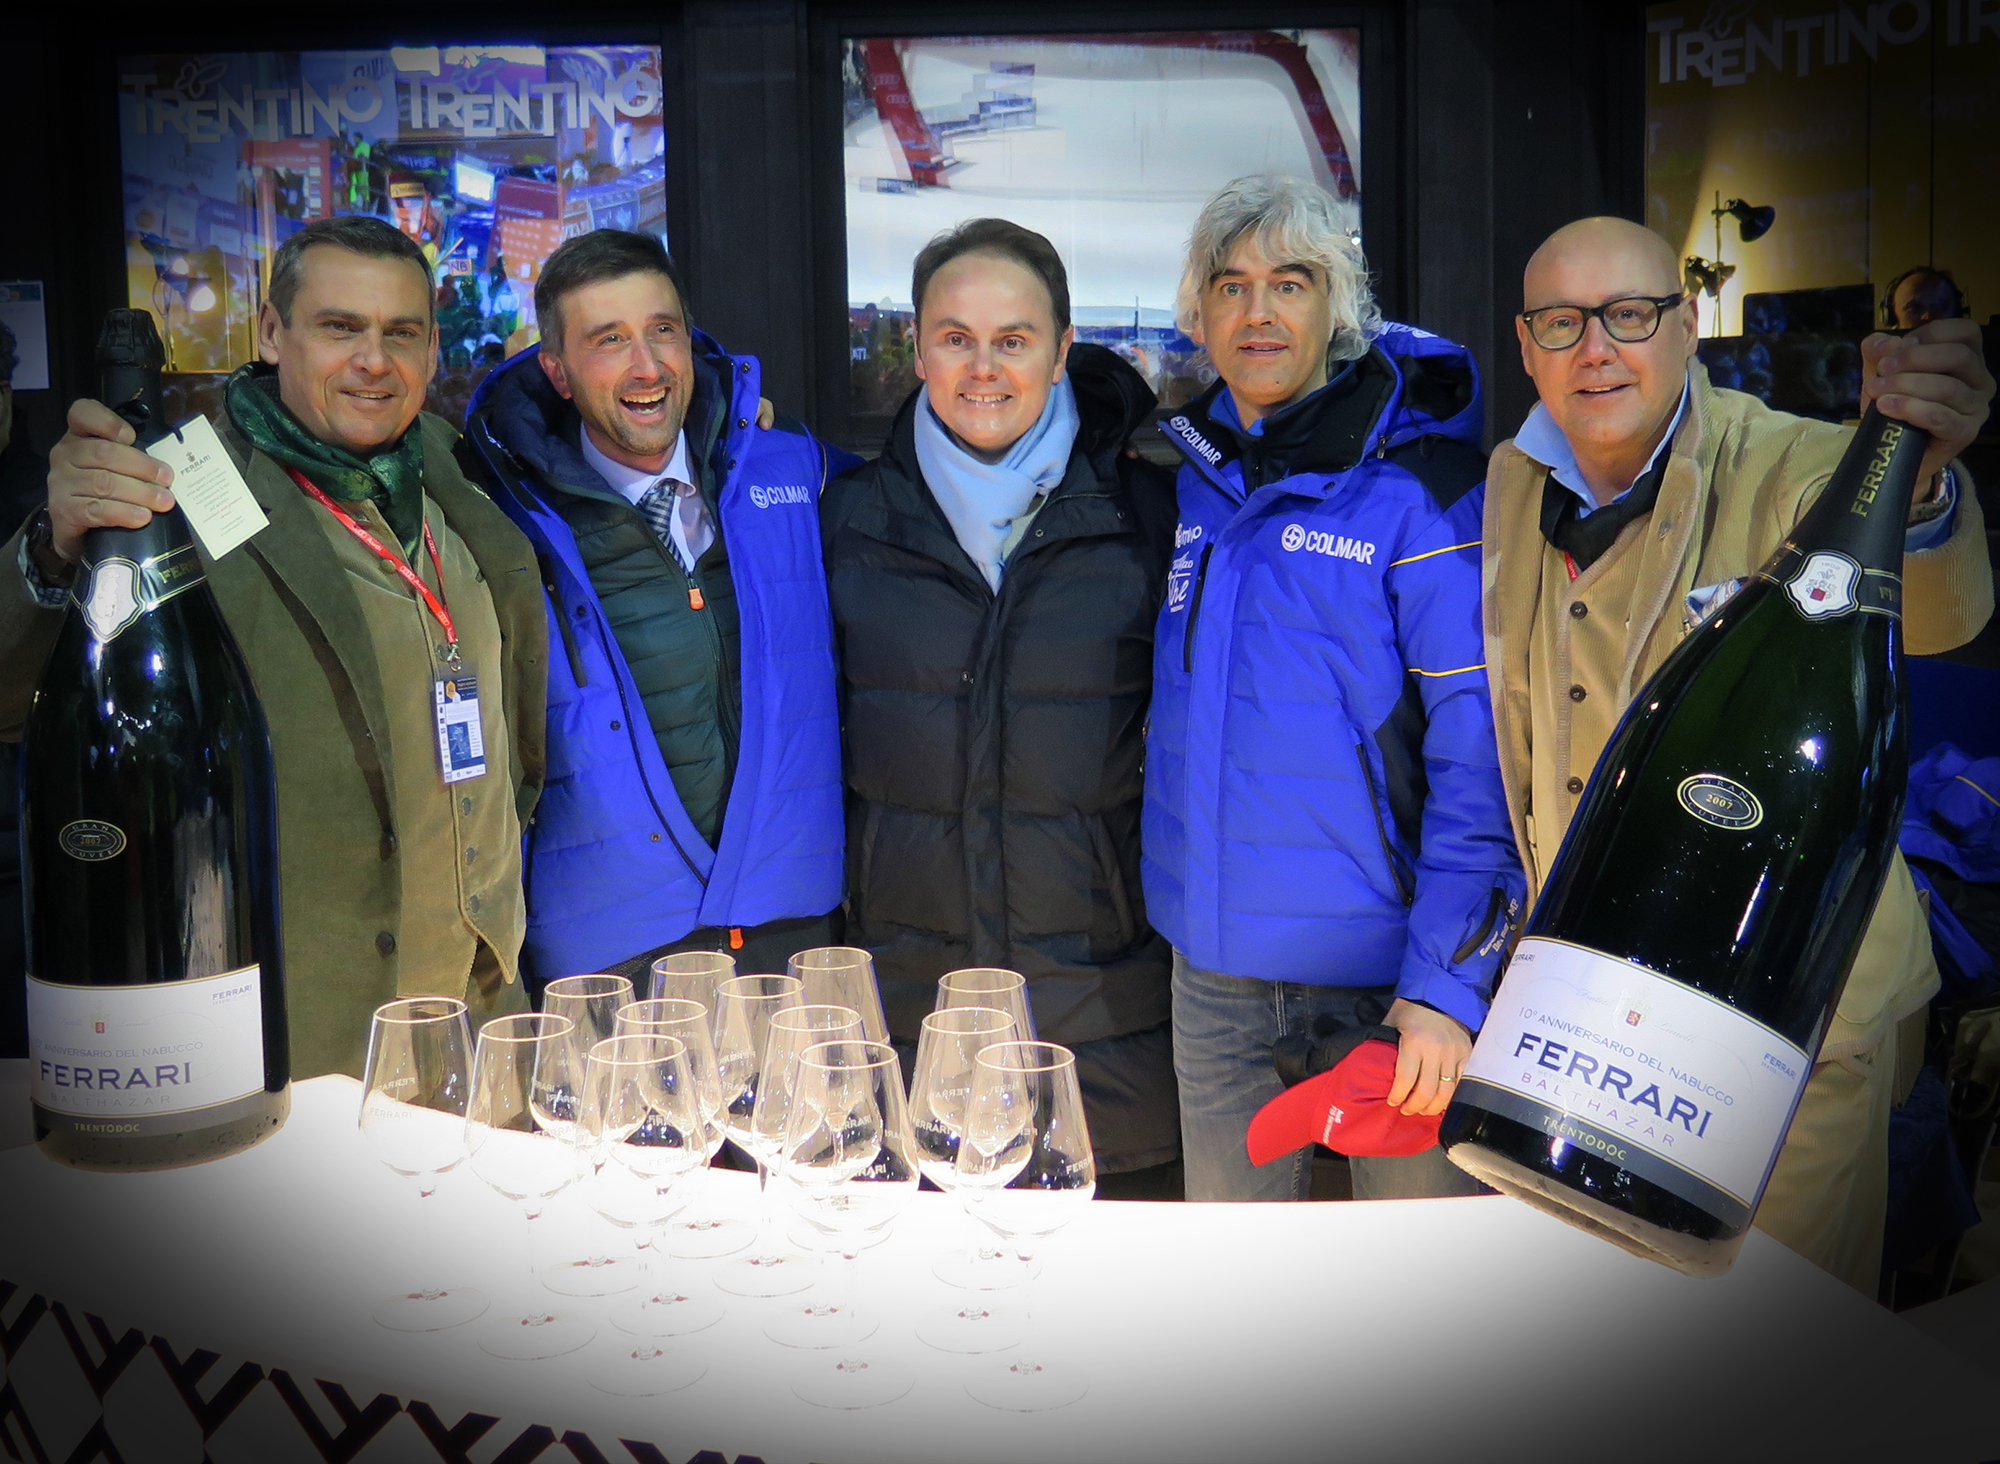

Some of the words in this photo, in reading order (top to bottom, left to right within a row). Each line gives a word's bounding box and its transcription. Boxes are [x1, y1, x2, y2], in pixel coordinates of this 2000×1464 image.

[1648, 0, 1931, 87] TRENTINO
[121, 75, 382, 143] TRENTINO
[397, 70, 660, 137] TRENTINO
[1181, 426, 1222, 465] COLMAR
[180, 454, 211, 477] FERRARI
[1850, 422, 1903, 517] FERRARI
[766, 486, 812, 505] COLMAR
[366, 533, 383, 551] Audi
[1305, 530, 1376, 565] COLMAR
[414, 578, 428, 594] Audi
[1702, 779, 1748, 799] GRAN
[1706, 793, 1733, 810] 2007
[72, 823, 109, 831] GRAN
[212, 984, 253, 1000] FERRARI
[44, 1043, 112, 1058] ANNIVERSARIO
[115, 1048, 139, 1058] DEL
[142, 1041, 204, 1056] NABUCCO
[1537, 1014, 1634, 1058] ANNIVERSARIO
[1638, 1052, 1665, 1073] DEL
[1669, 1066, 1734, 1106] NABUCCO
[40, 1060, 192, 1090] FERRARI
[1763, 1051, 1797, 1081] FERRARI
[1513, 1032, 1713, 1139] FERRARI
[51, 1092, 170, 1107] BALTHAZAR
[1520, 1072, 1676, 1147] BALTHAZAR
[370, 1107, 412, 1119] FERRARI
[74, 1123, 141, 1133] TRENTODOC
[1541, 1114, 1628, 1162] TRENTODOC
